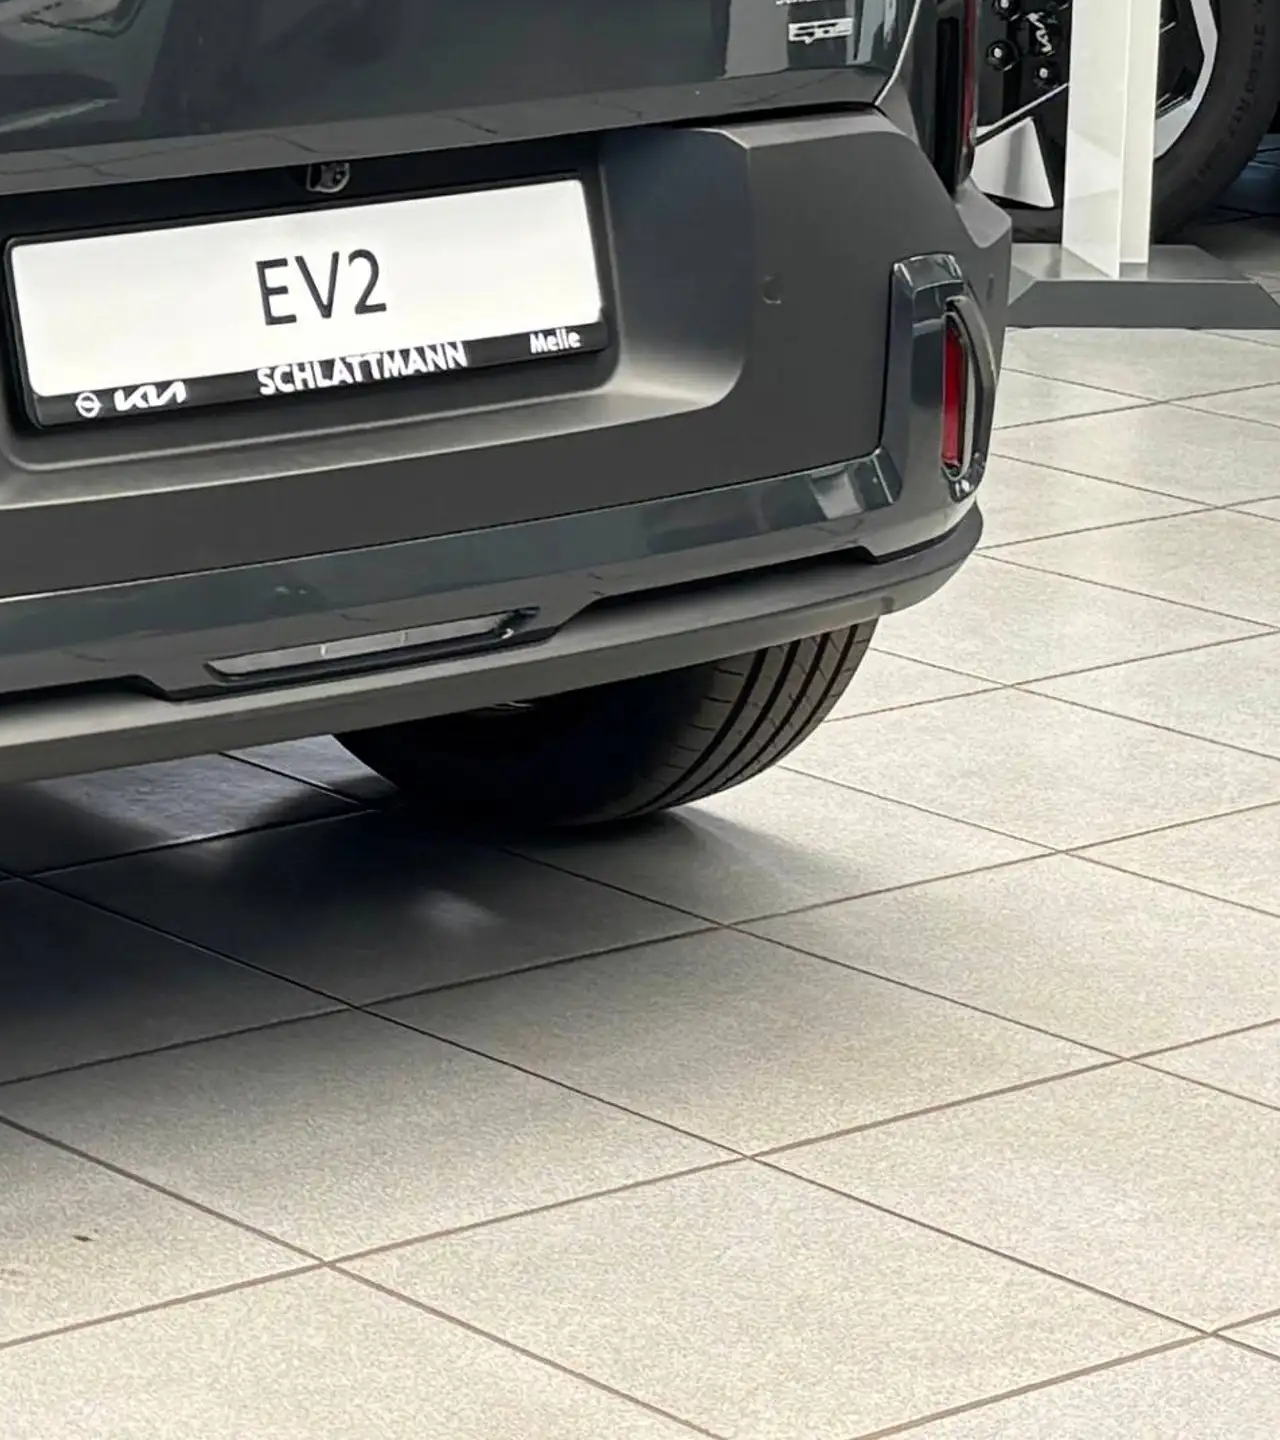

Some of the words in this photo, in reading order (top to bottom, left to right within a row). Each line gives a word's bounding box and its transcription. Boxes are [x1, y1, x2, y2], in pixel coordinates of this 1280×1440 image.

[256, 247, 387, 326] EV2
[529, 328, 581, 354] Melle
[113, 380, 189, 412] KIA
[257, 342, 468, 397] SCHLATTMANN
